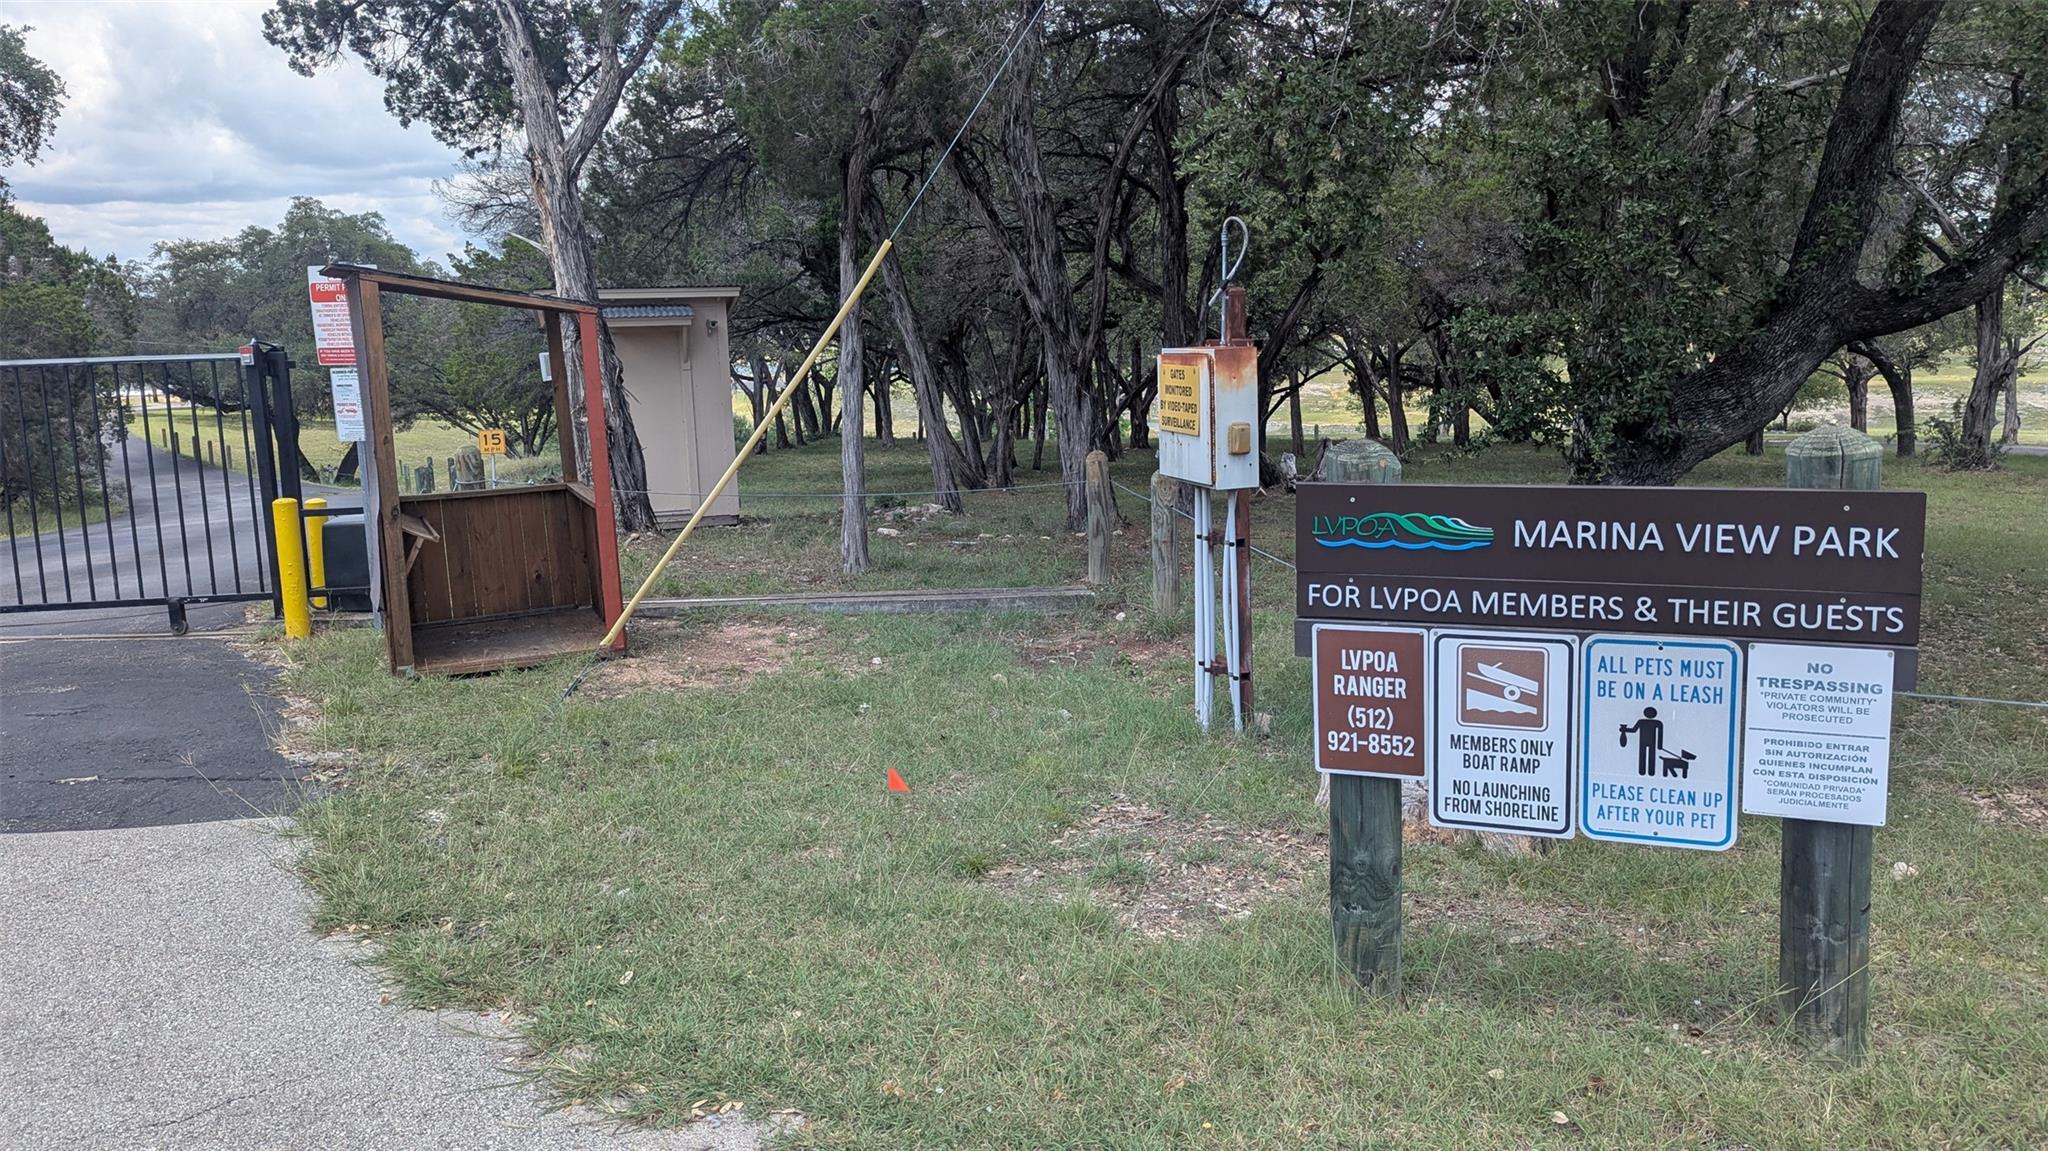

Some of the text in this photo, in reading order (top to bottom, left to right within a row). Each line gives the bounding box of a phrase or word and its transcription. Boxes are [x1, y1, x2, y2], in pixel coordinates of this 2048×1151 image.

[315, 283, 340, 292] PERMIT
[336, 293, 346, 302] ON
[1170, 368, 1186, 380] GATES
[1165, 384, 1192, 397] MONITORED
[1160, 400, 1197, 414] BY VIDEO-TAPED
[1162, 416, 1196, 430] SURVEILLANCE
[484, 434, 502, 446] 15
[1312, 515, 1900, 558] LVPOA MARINA VIEW PARK
[1308, 584, 1904, 633] FOR LVPOA MEMBERS & THEIR GUESTS
[1341, 649, 1398, 672] LVPOA
[1598, 656, 1724, 680] ALL PETS MUST
[1807, 662, 1833, 674] NO
[1334, 674, 1407, 700] RANGER
[1597, 680, 1723, 704] BE ON A LEASH
[1756, 677, 1883, 695] TRESPASSING
[1766, 701, 1870, 715] VIOLATORS WILL BE
[1348, 705, 1394, 730] (512)
[1782, 712, 1853, 725] PROSECUTED
[1328, 731, 1414, 757] 921-8552
[1450, 734, 1554, 757] MEMBERS ONLY
[1764, 738, 1870, 753] PROHIBIDO ENTRAR
[1463, 754, 1540, 774] BOAT RAMP
[1786, 750, 1867, 763] AUTORIZACIÓN
[1758, 758, 1873, 774] QUIENES INCUMPLAN
[1753, 769, 1878, 785] CON ESTA DISPOSICIÓN
[1453, 780, 1550, 803] NO LAUNCHING
[1592, 783, 1722, 808] PLEASE CLEAN UP
[1799, 790, 1862, 802] PROCESADOS
[1444, 797, 1559, 822] FROM SHORELINE
[1778, 797, 1849, 810] JUDICIALMENTE
[1597, 804, 1716, 829] AFTER YOUR PET
